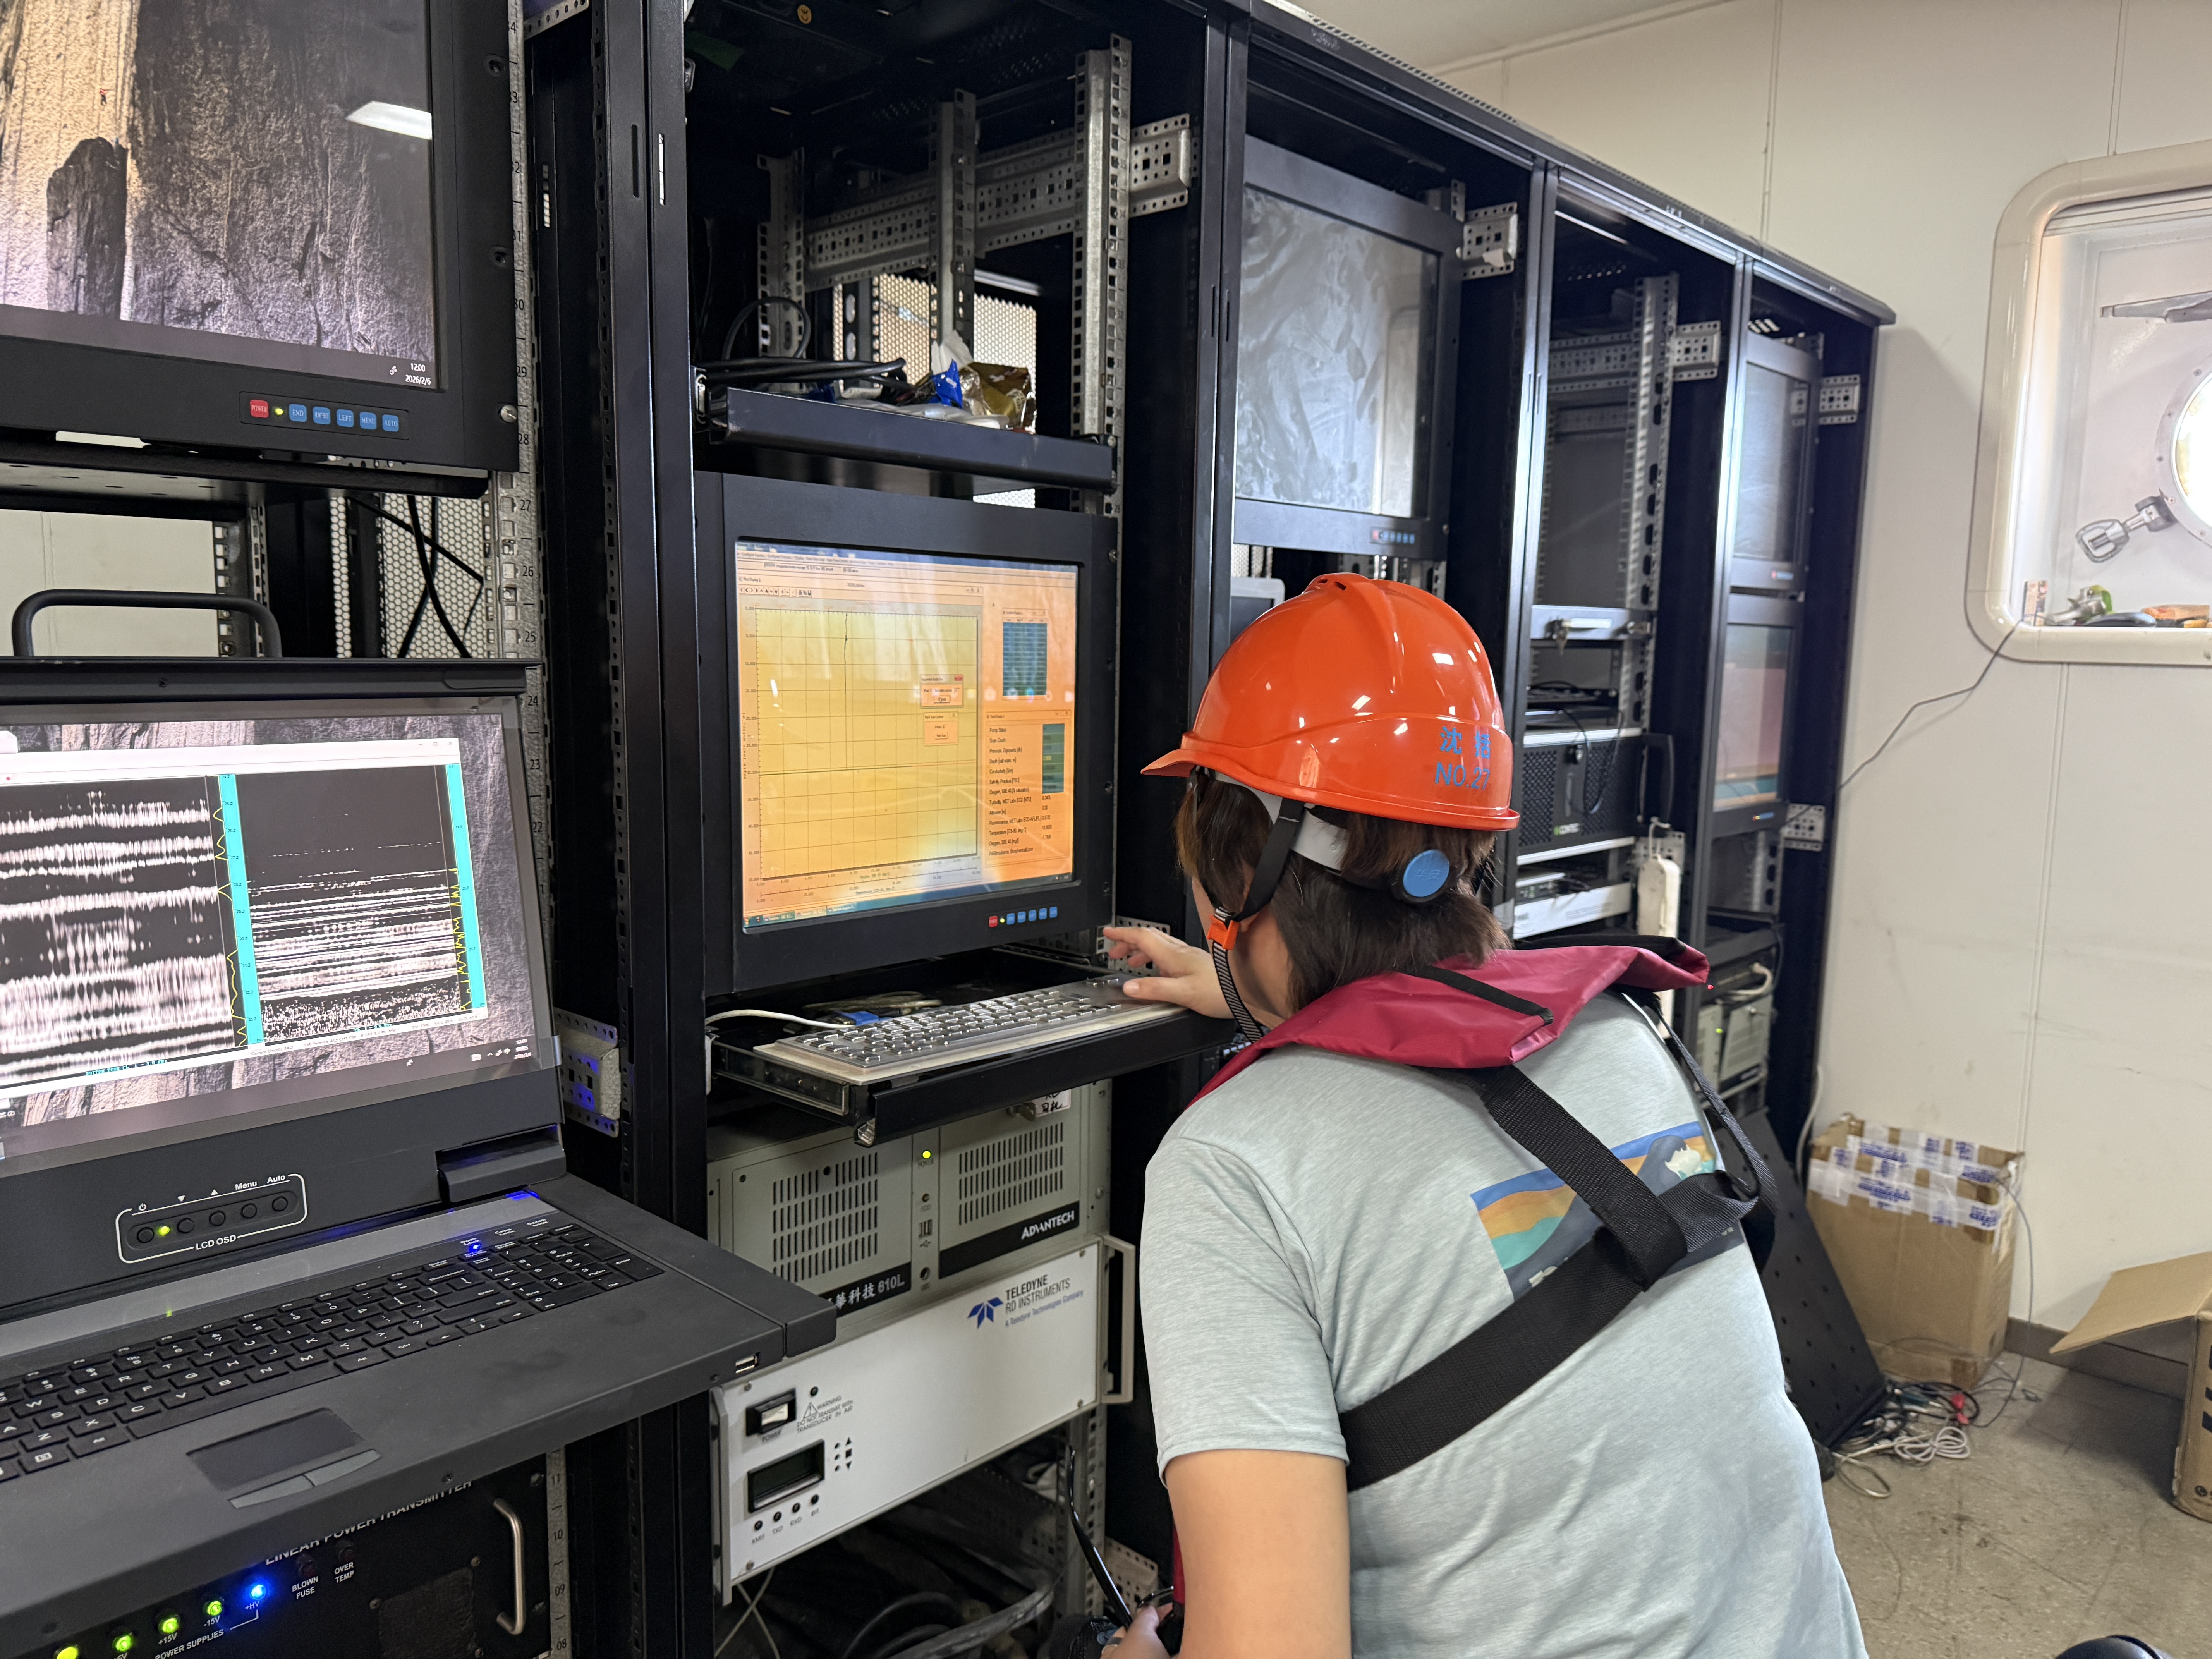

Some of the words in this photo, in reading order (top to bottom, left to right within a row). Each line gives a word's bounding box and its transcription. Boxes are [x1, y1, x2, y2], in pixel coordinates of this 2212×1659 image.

[510, 21, 517, 34] 4
[511, 91, 517, 104] 3
[513, 161, 520, 173] 2
[410, 363, 426, 373] 12:00
[517, 366, 527, 378] 29
[405, 374, 431, 385] 2026/2/6
[518, 433, 529, 445] 28
[520, 500, 531, 511] 27
[523, 565, 534, 577] 26
[525, 631, 536, 642] 25
[527, 695, 538, 706] 24
[1440, 726, 1491, 759] 沈括
[530, 759, 540, 770] 23
[1435, 762, 1491, 790] NO.27
[532, 822, 543, 832] 22
[235, 1178, 258, 1191] Menu
[266, 1173, 286, 1185] Auto
[1021, 1209, 1075, 1240] ADVANTECH
[195, 1237, 214, 1252] LCD
[216, 1233, 237, 1248] OSD
[828, 1283, 876, 1309] 華科技
[878, 1274, 905, 1293] 610L
[1006, 1274, 1048, 1300] TELEDYNE
[1006, 1300, 1016, 1314] RD
[1018, 1278, 1070, 1308] INSTRUMENTS
[26, 1399, 43, 1408] W
[817, 1396, 842, 1410] WARNING
[797, 1418, 805, 1427] DO
[797, 1415, 833, 1433] TRANSDUCER
[38, 1432, 52, 1441] Z
[762, 1430, 781, 1443] POWER
[551, 1473, 560, 1484] 11
[553, 1529, 563, 1541] 10
[334, 1562, 354, 1575] OVER
[335, 1570, 354, 1583] TEMP
[292, 1576, 319, 1592] BLOWN
[555, 1584, 565, 1596] 09
[296, 1586, 315, 1600] FUSE
[245, 1601, 260, 1611] +HV
[204, 1616, 220, 1627] -15V
[155, 1645, 185, 1659] POWER
[186, 1629, 224, 1650] SUPPLIES
[158, 1633, 178, 1645] +15V
[556, 1638, 567, 1650] 08
